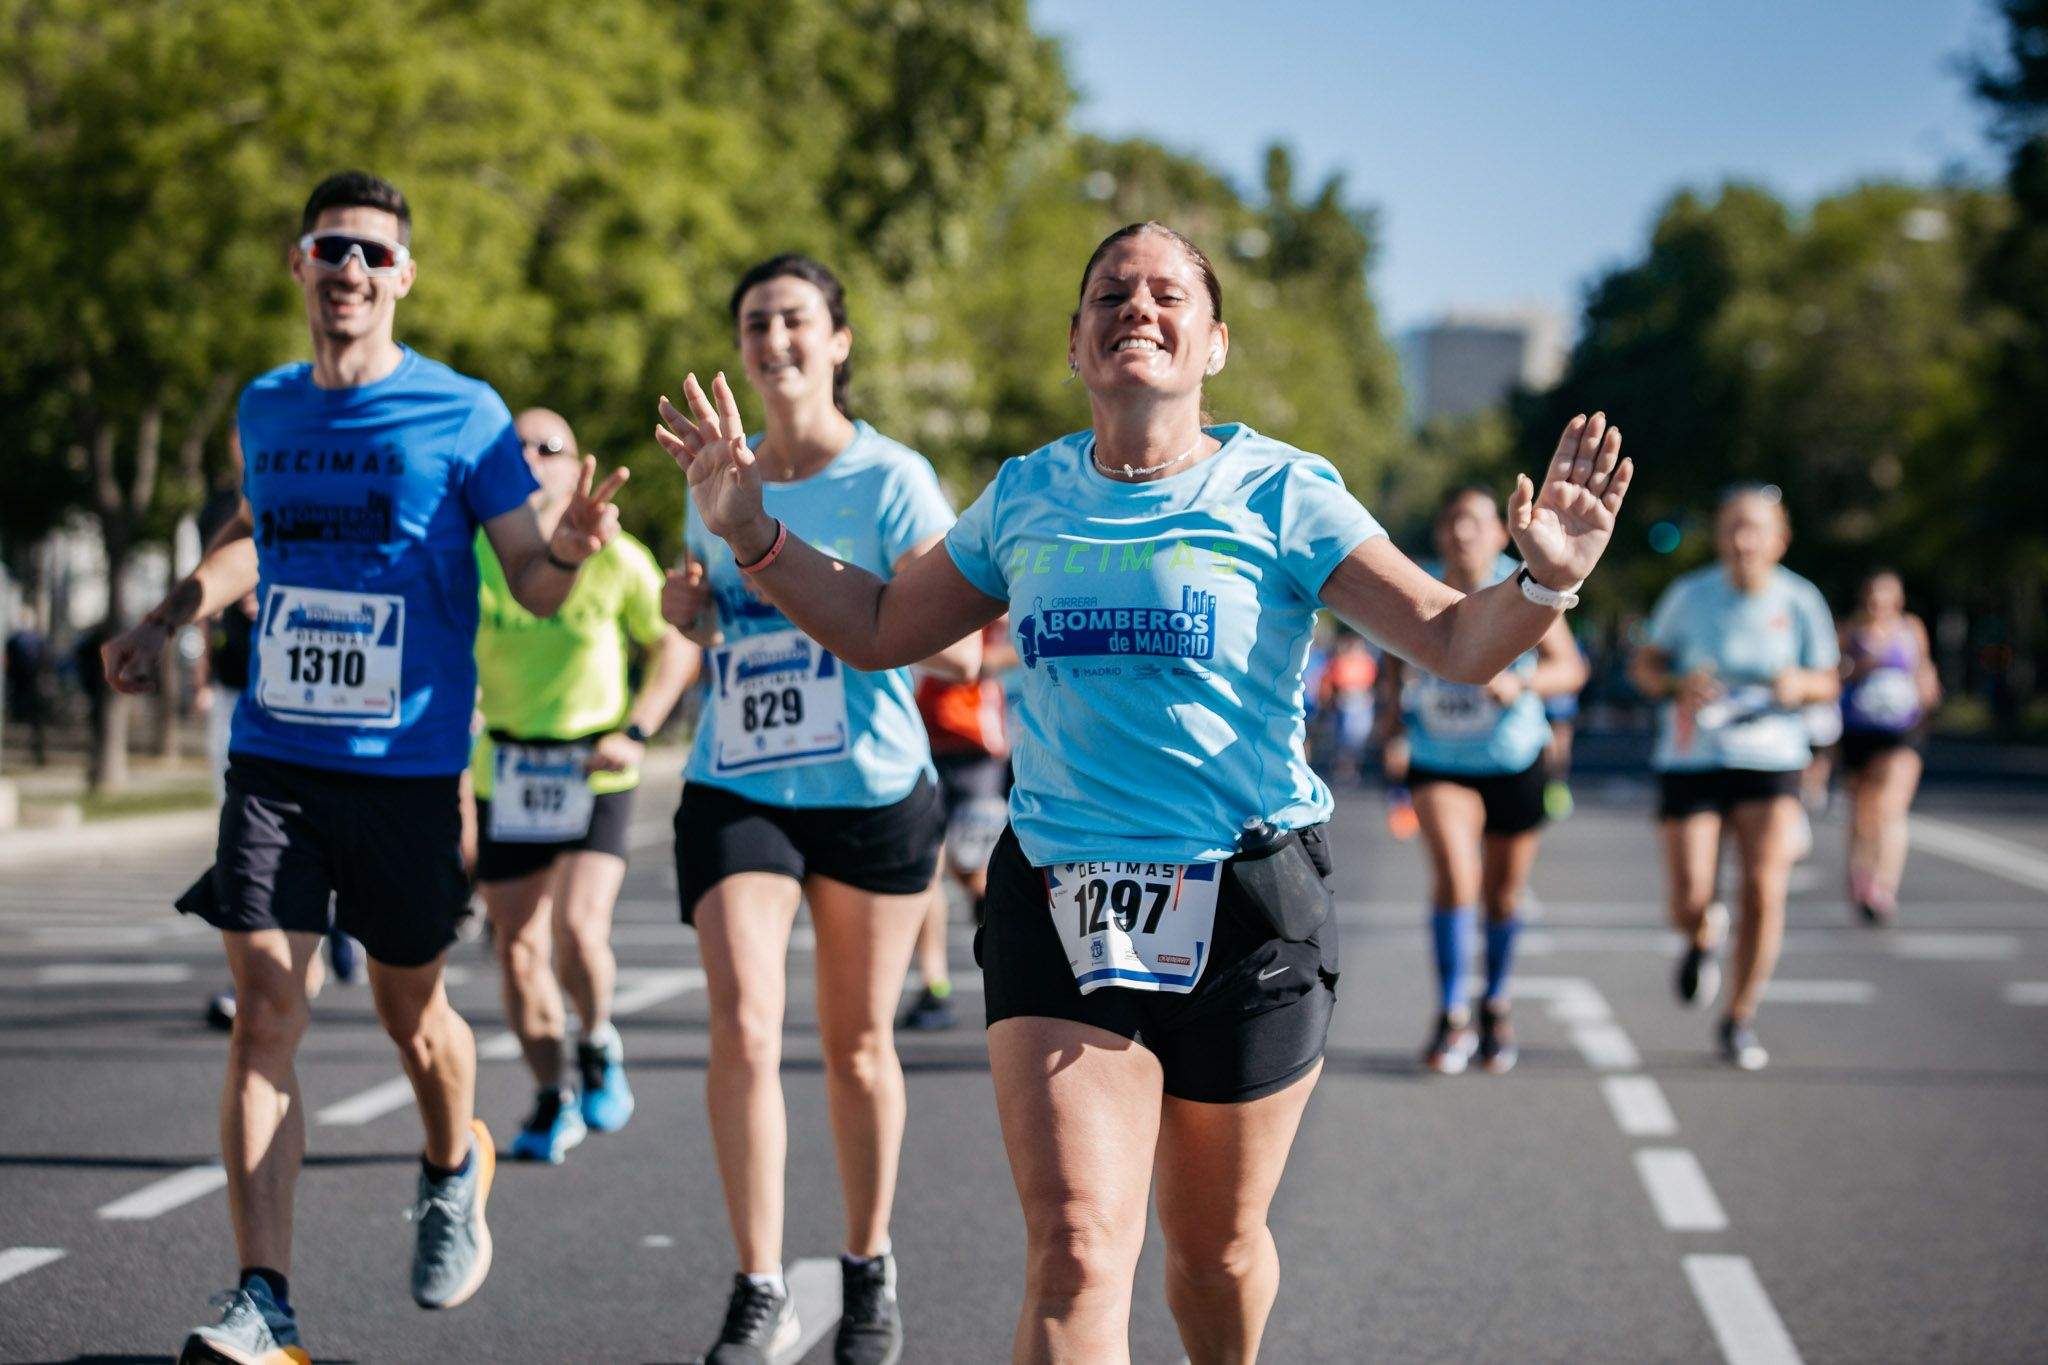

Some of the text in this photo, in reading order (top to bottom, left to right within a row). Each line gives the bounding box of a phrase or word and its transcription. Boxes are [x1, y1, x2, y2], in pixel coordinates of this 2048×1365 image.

[255, 449, 405, 475] DECIMAS
[1008, 540, 1239, 578] DECIMAS
[1051, 596, 1098, 609] CARRERA
[1051, 610, 1209, 635] BOMBEROS
[1109, 631, 1209, 657] de MADRID
[287, 646, 366, 688] 1310
[1083, 666, 1122, 677] MADRID
[742, 687, 804, 733] 829
[1074, 878, 1171, 938] 1297
